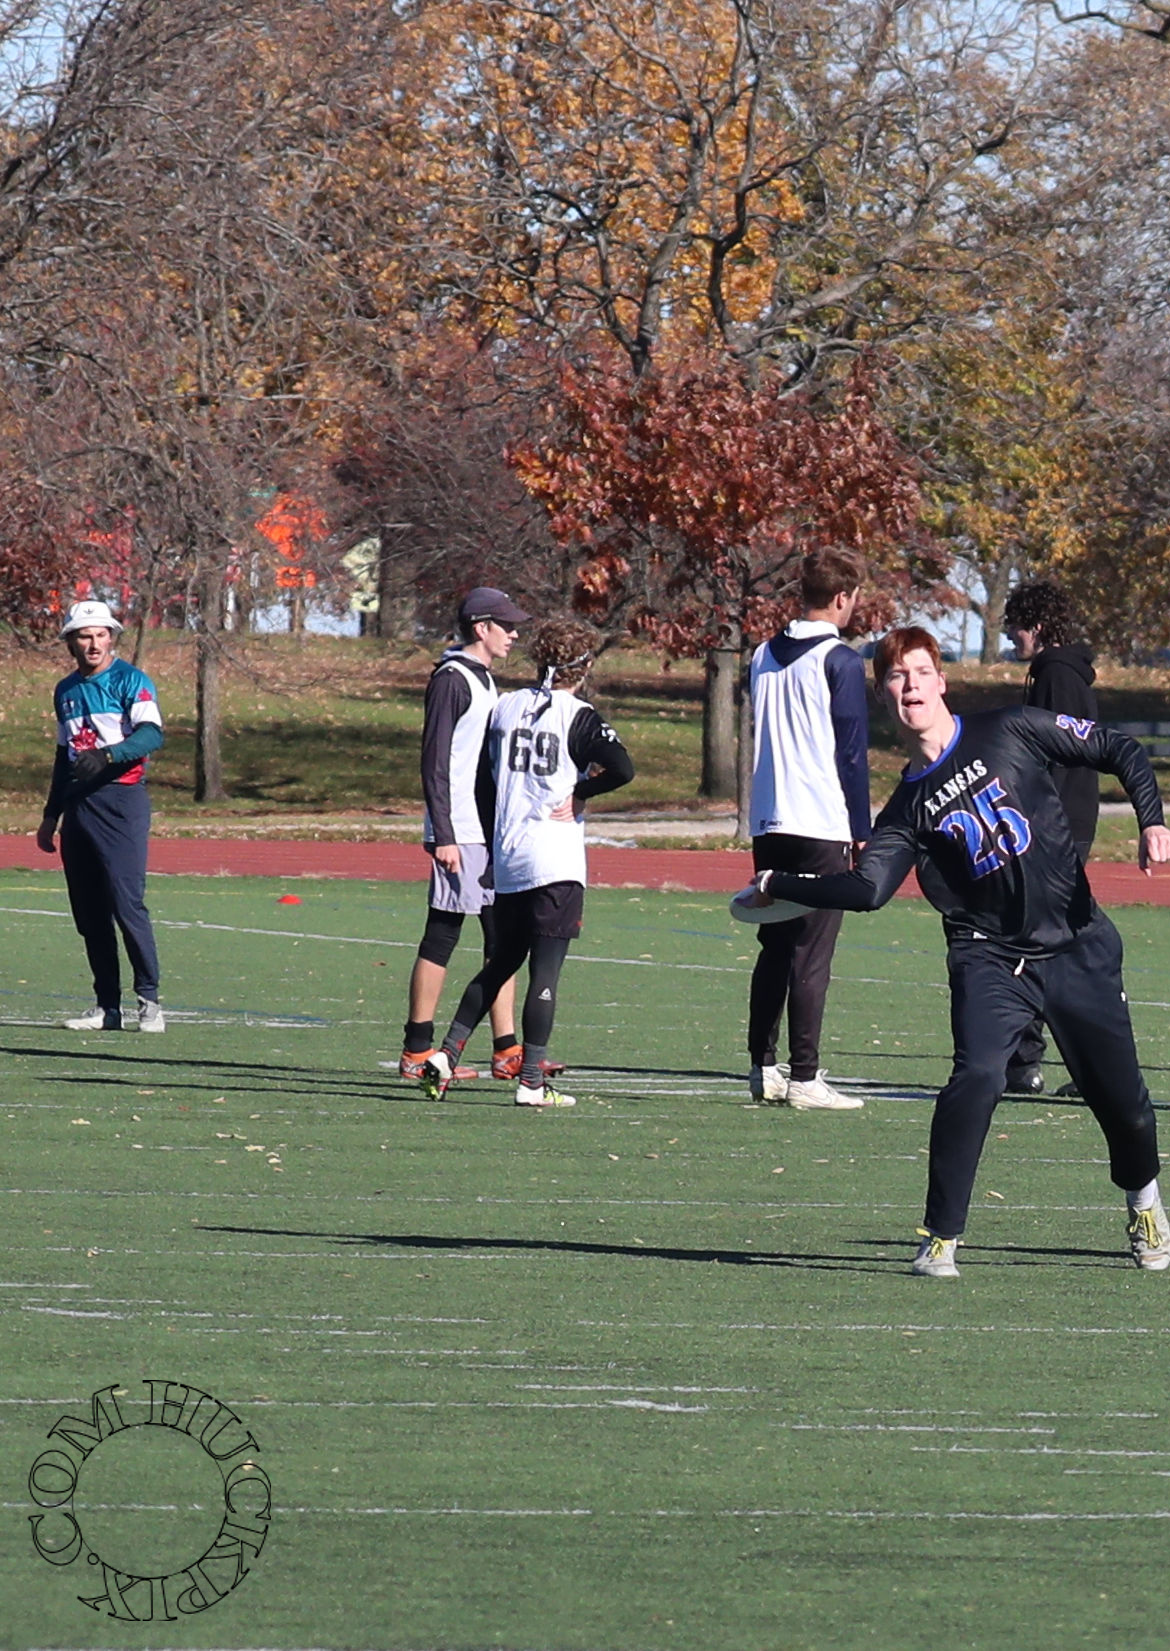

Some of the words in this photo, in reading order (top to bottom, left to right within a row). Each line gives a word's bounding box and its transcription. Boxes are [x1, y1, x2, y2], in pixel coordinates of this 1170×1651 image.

[508, 727, 560, 777] 69
[924, 758, 988, 816] KANSAS
[934, 777, 1032, 881] 25
